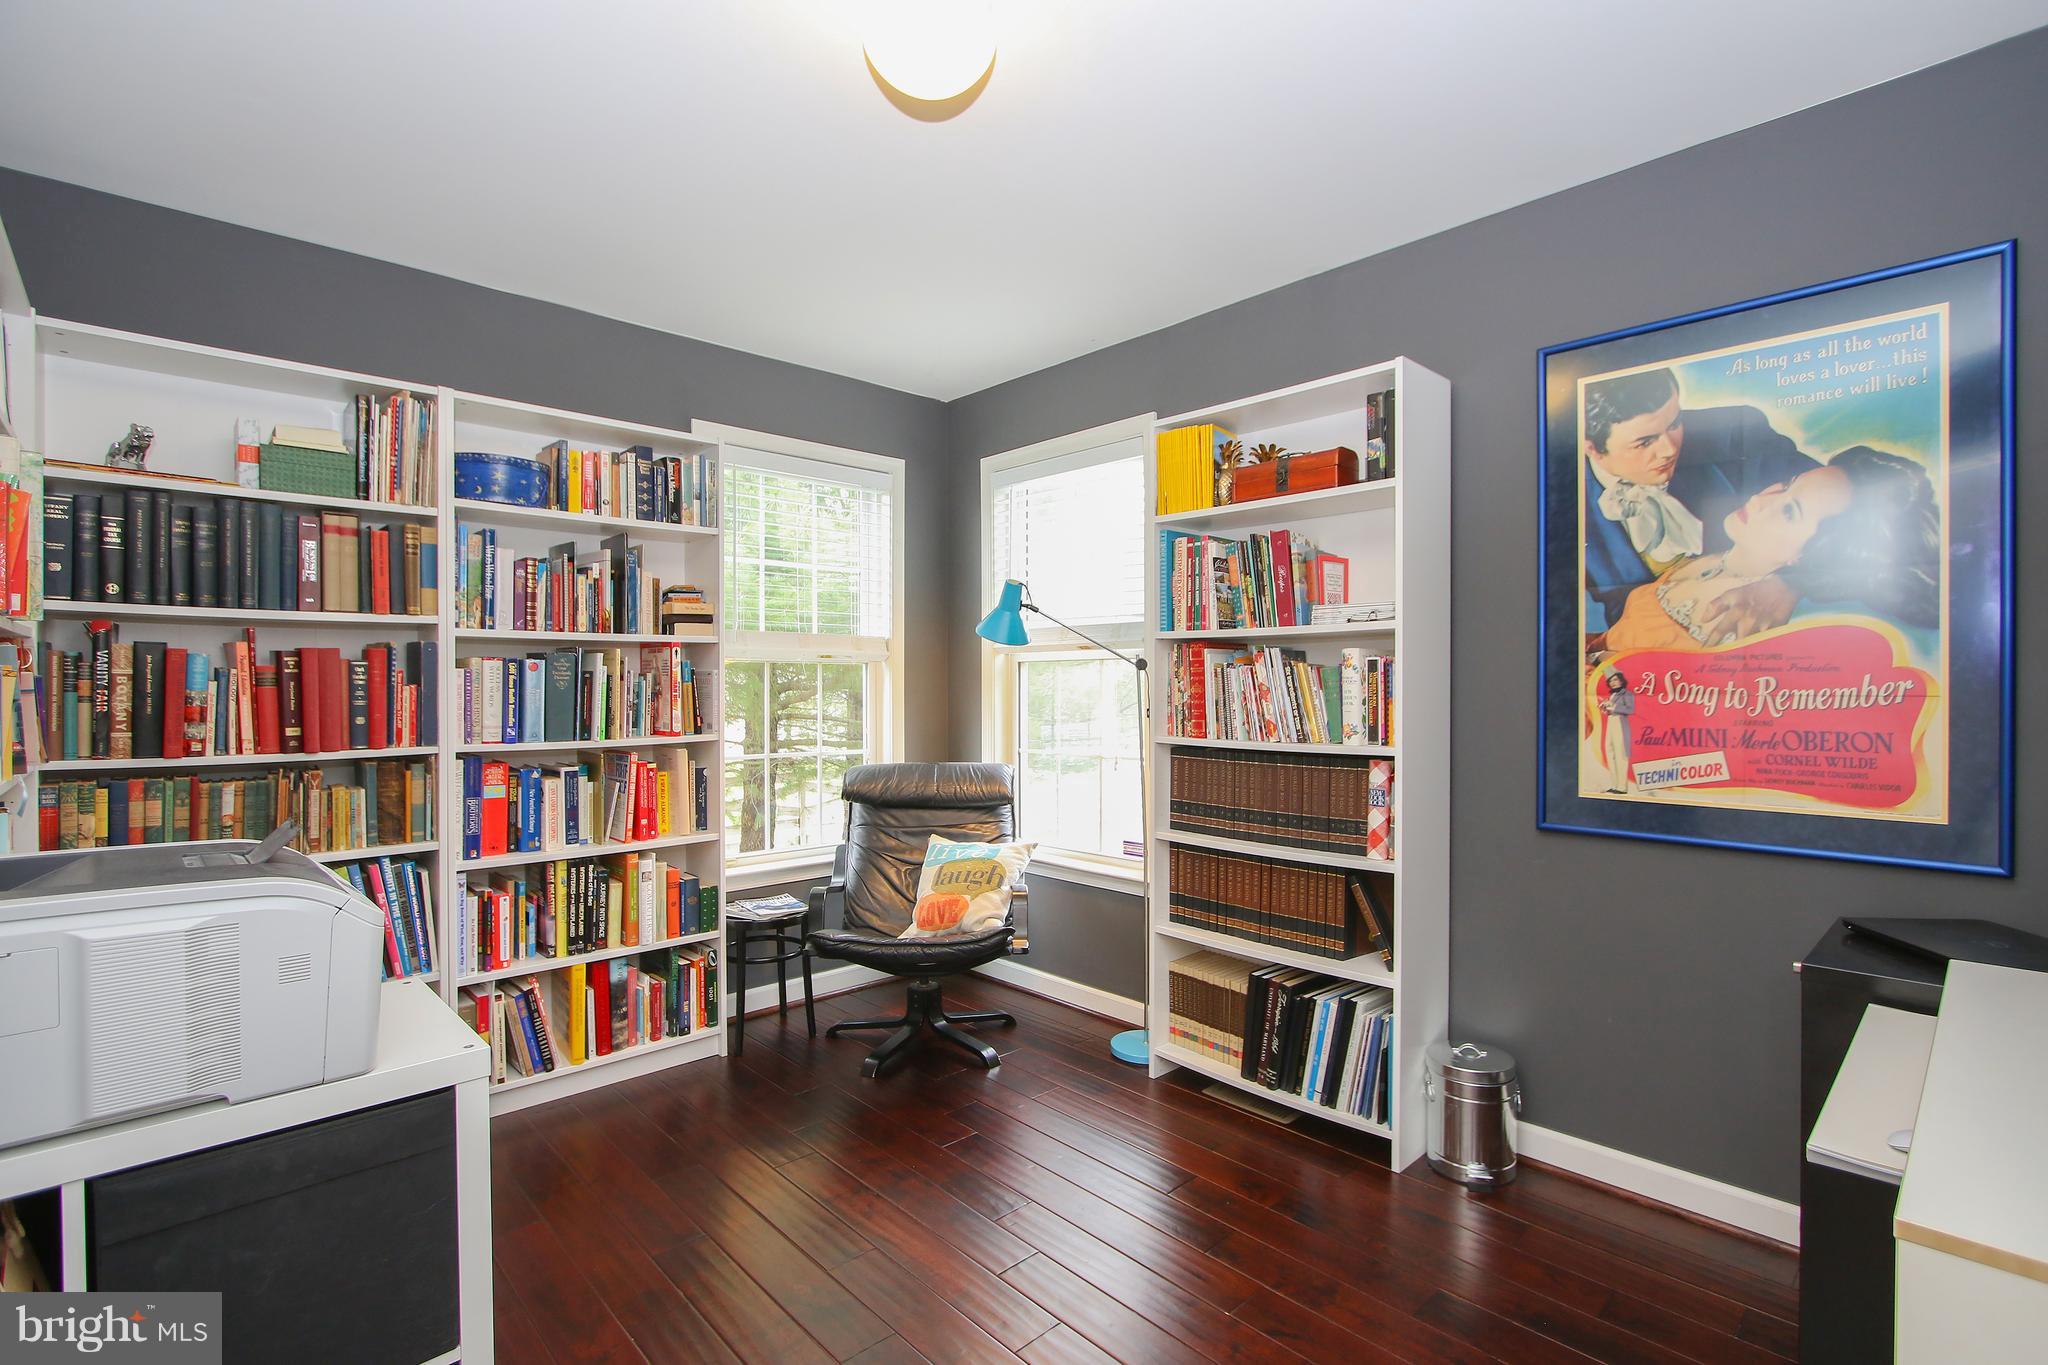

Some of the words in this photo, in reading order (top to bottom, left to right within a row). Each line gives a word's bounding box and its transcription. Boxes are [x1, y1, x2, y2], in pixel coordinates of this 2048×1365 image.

[1726, 358, 1751, 376] As
[1755, 355, 1788, 370] long
[1793, 351, 1811, 363] as
[1818, 341, 1838, 358] all
[1844, 336, 1872, 353] the
[1877, 322, 1927, 346] world
[1776, 370, 1815, 387] loves
[1820, 369, 1830, 379] a
[1777, 387, 1843, 408] romance
[1850, 377, 1880, 396] will
[1278, 565, 1287, 593] Recipes
[96, 650, 109, 686] VANITY
[96, 689, 108, 713] FAIR
[115, 675, 128, 732] BOTANY
[1634, 671, 1656, 696] A
[1658, 669, 1719, 717] Song
[1724, 681, 1747, 709] to
[1747, 673, 1914, 718] Remember
[473, 707, 481, 727] HINTS
[1634, 726, 1667, 746] Paul
[1667, 727, 1728, 748] MUNI
[1782, 729, 1893, 754] OBERON
[1636, 763, 1723, 785] TECHNICOLOR
[1765, 753, 1821, 767] CORNEL
[1824, 756, 1877, 769] WILDE
[467, 799, 477, 834] BIRTHDAYS
[547, 863, 555, 883] GREAT
[569, 867, 577, 895] MYSTERIES
[578, 866, 586, 894] MYSTERIES
[934, 863, 1004, 891] laugh
[382, 858, 396, 891] MOMENTS
[391, 902, 400, 918] TIME
[548, 883, 556, 916] DISASTERS
[599, 882, 607, 907] JOURNEY
[412, 896, 420, 917] WORLD
[415, 918, 425, 945] RECORDS
[1266, 987, 1274, 1020] UNIVERSITY
[1265, 1021, 1271, 1030] OF
[1260, 1032, 1268, 1062] MARYLAND
